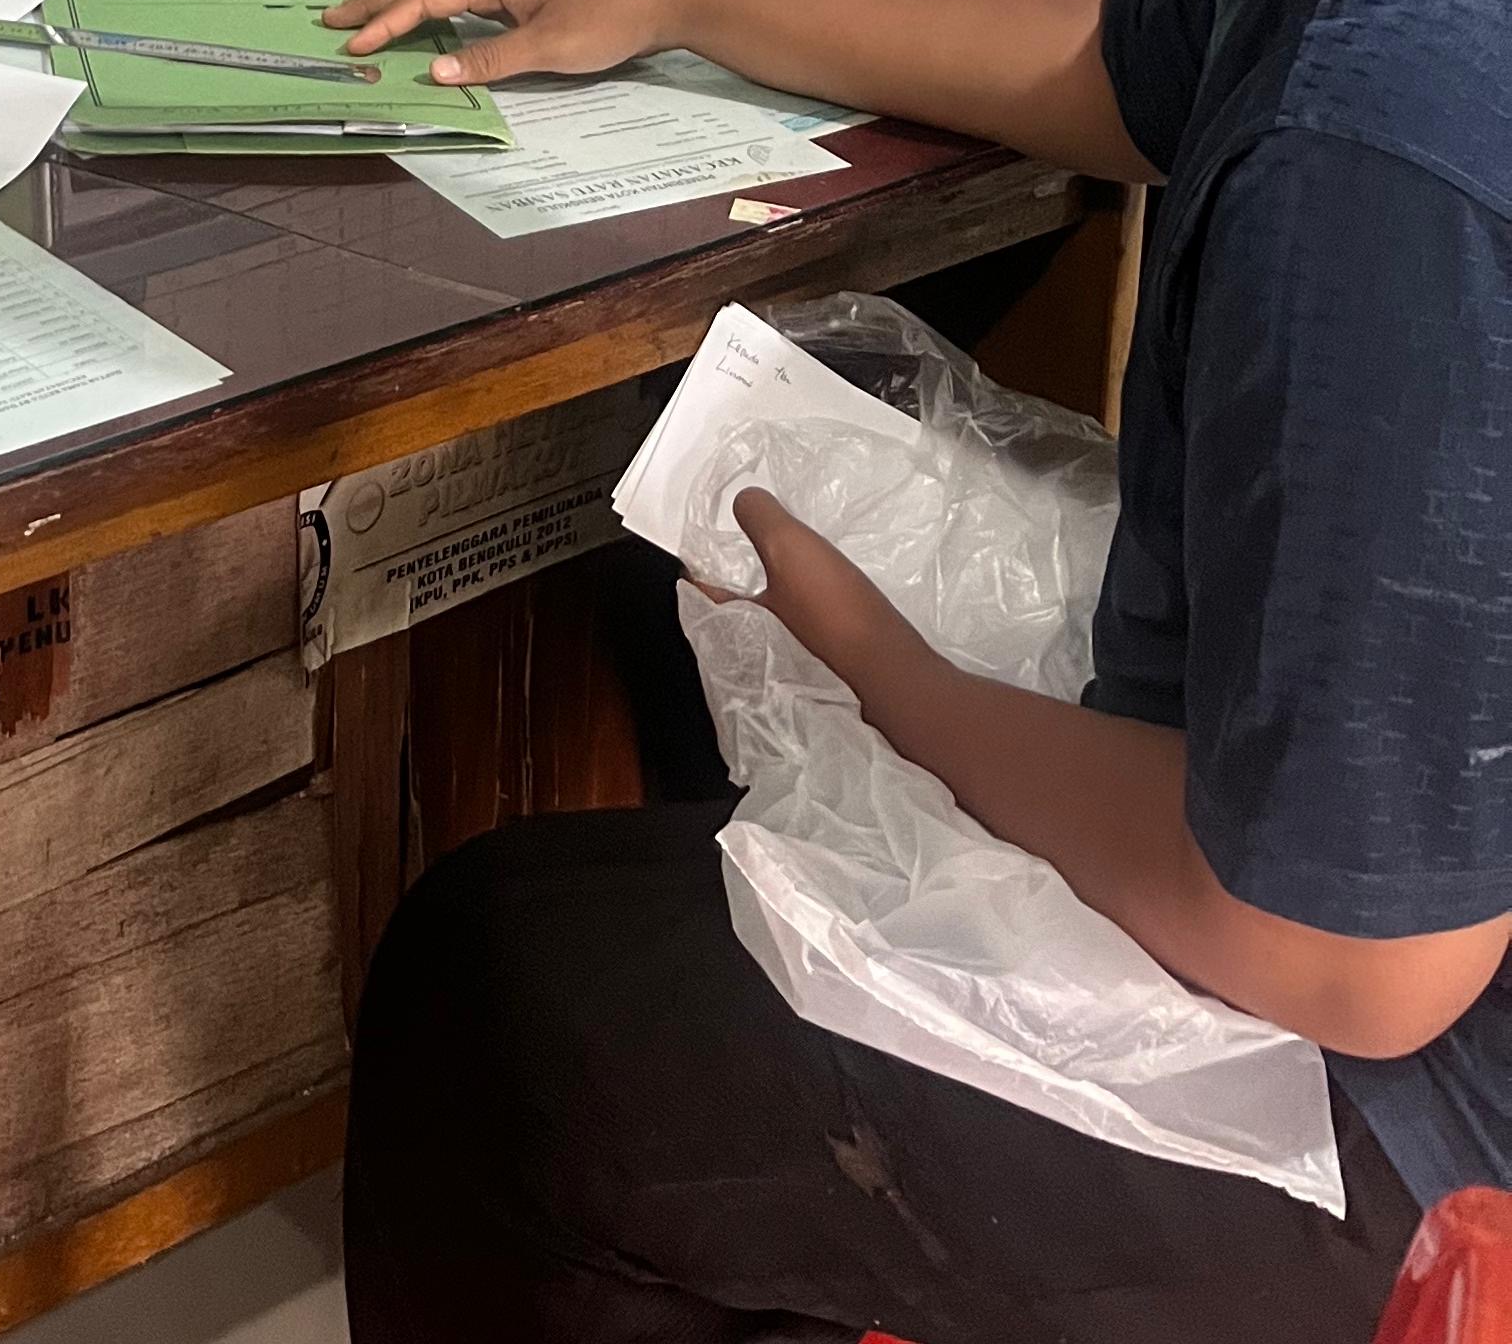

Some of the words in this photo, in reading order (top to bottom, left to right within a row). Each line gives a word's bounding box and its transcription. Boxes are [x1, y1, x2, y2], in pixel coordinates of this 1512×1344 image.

[572, 172, 632, 198] RATU
[635, 155, 743, 188] KECAMATAN
[485, 185, 567, 216] SAMBAN
[387, 523, 508, 583] PENYELENGGARA
[512, 487, 604, 532] PEMILUKADA
[417, 565, 454, 591] KOTA
[458, 533, 532, 574] BENGKULU
[535, 514, 572, 544] 2012
[488, 554, 517, 578] PPS
[520, 548, 531, 564] &
